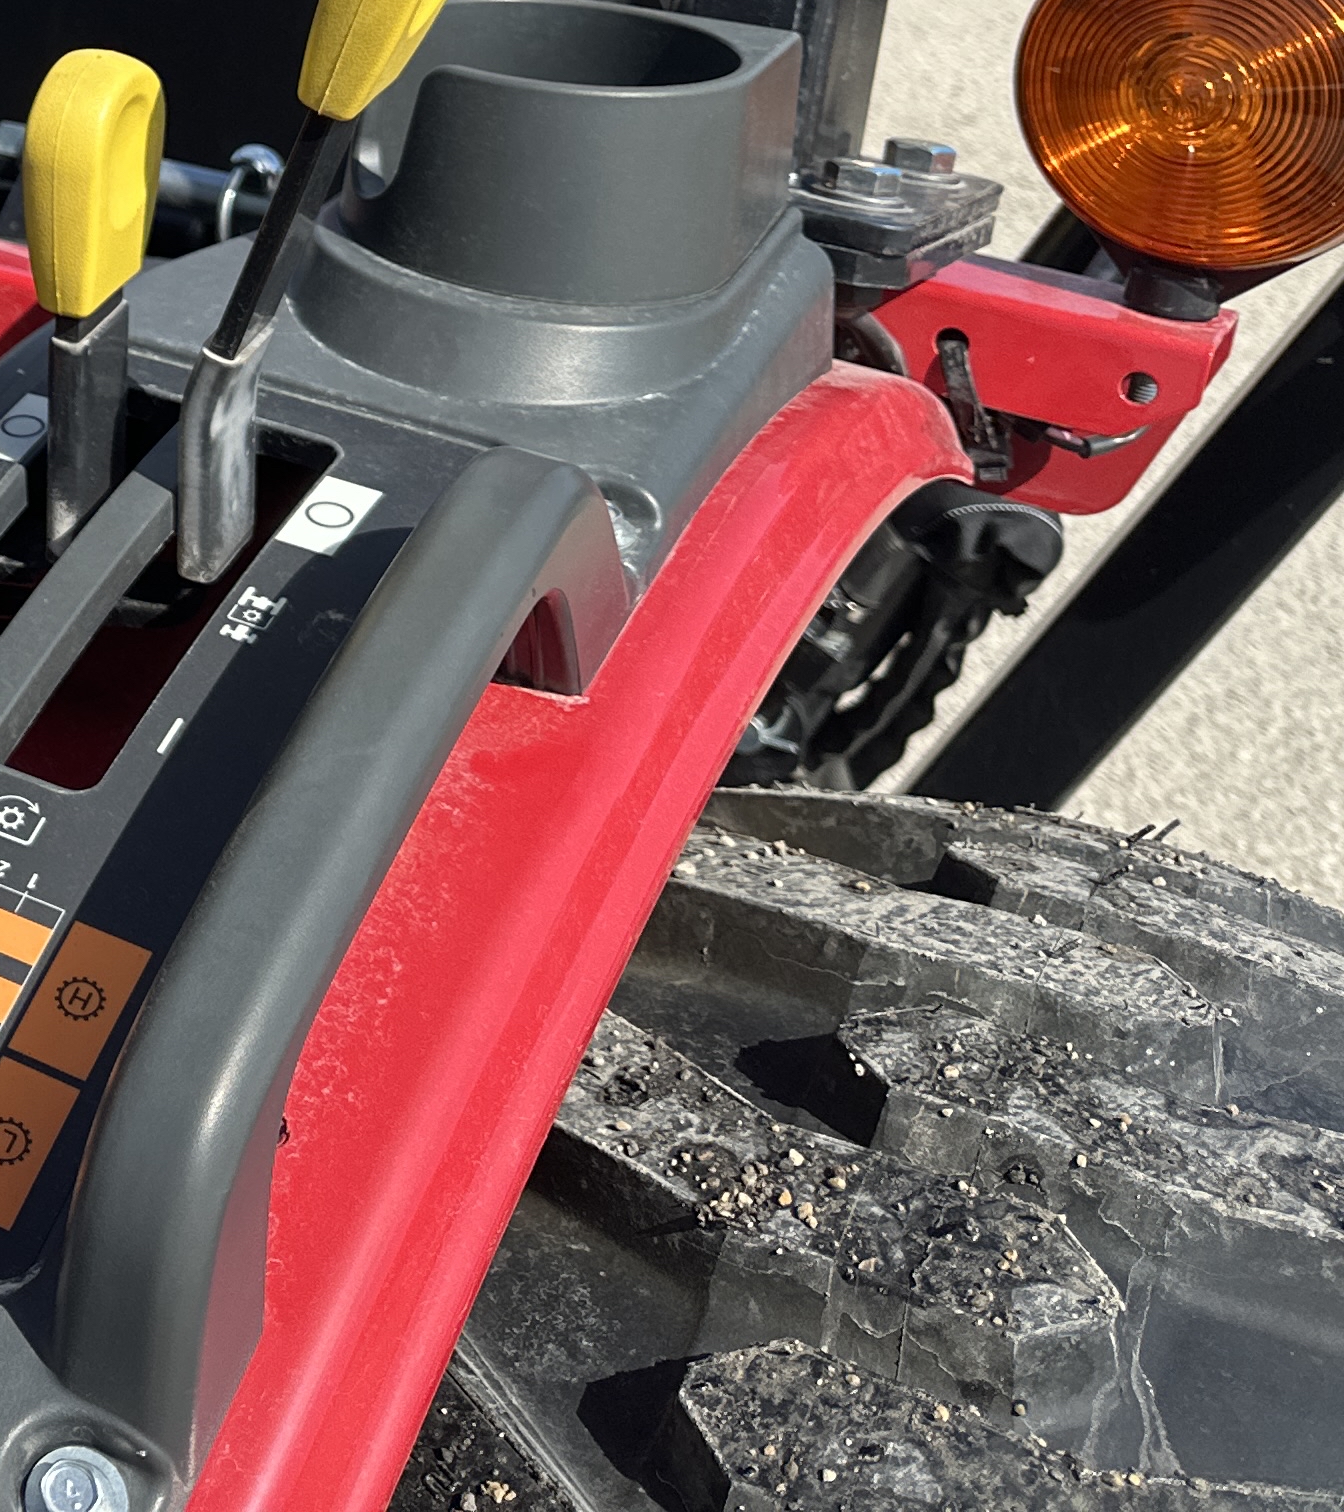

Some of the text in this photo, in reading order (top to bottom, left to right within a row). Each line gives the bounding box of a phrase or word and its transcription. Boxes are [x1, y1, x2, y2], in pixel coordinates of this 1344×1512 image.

[27, 873, 40, 889] 1
[68, 986, 93, 1011] H
[3, 1128, 18, 1153] L
